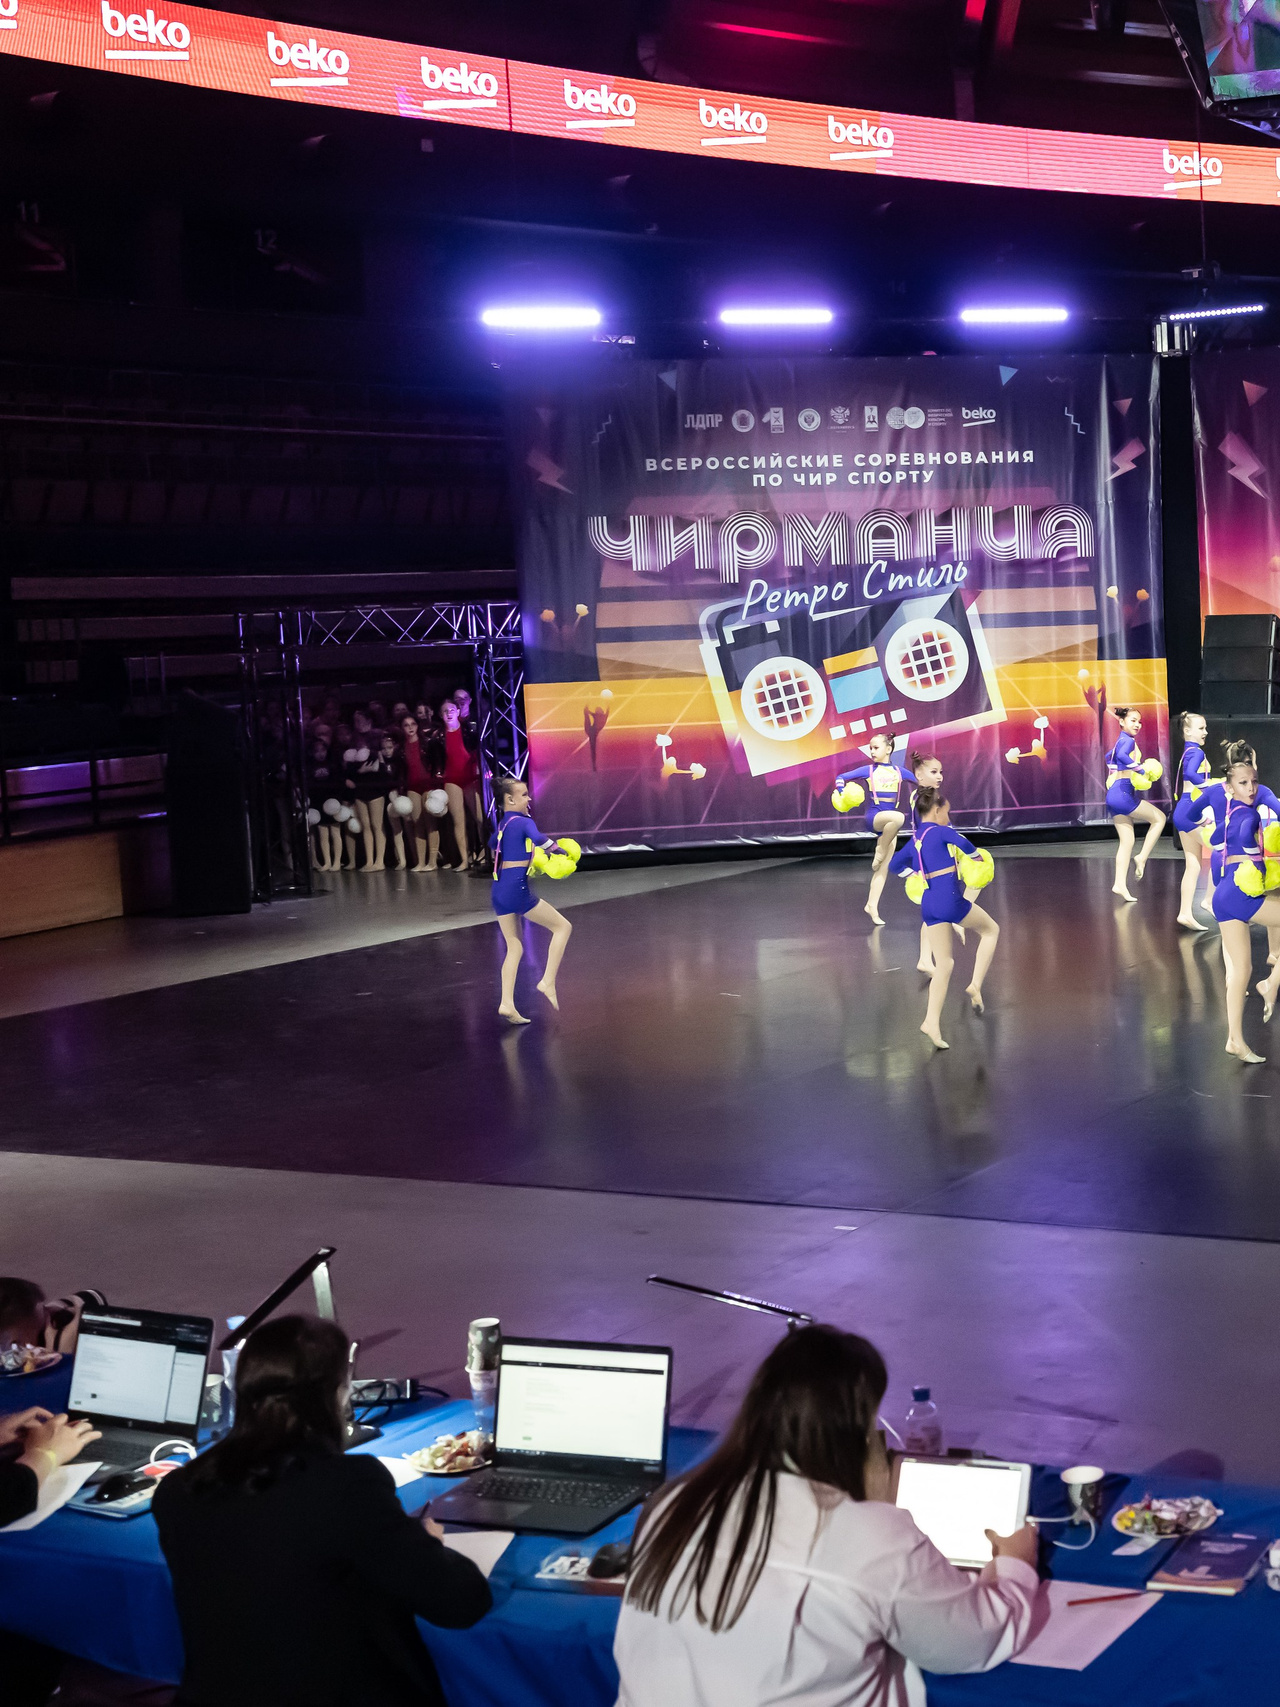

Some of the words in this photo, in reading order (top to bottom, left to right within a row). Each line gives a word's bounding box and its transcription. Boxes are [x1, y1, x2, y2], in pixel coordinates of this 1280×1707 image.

[102, 1, 191, 49] beko
[267, 32, 350, 76] beko
[420, 57, 499, 98] beko
[563, 79, 637, 117] beko
[699, 99, 769, 134] beko
[828, 115, 895, 149] beko
[1163, 149, 1223, 177] beko
[684, 414, 723, 430] ЛДПР
[962, 406, 997, 419] beko
[645, 453, 844, 471] ВСЕРОССИЙСКИЕ
[853, 450, 1035, 467] СОРЕВНОВАНИЯ
[752, 473, 783, 487] ПО
[792, 473, 838, 487] ЧИР
[847, 470, 935, 486] СПОРТУ
[741, 579, 849, 620] Ретро
[863, 559, 968, 600] Стиль
